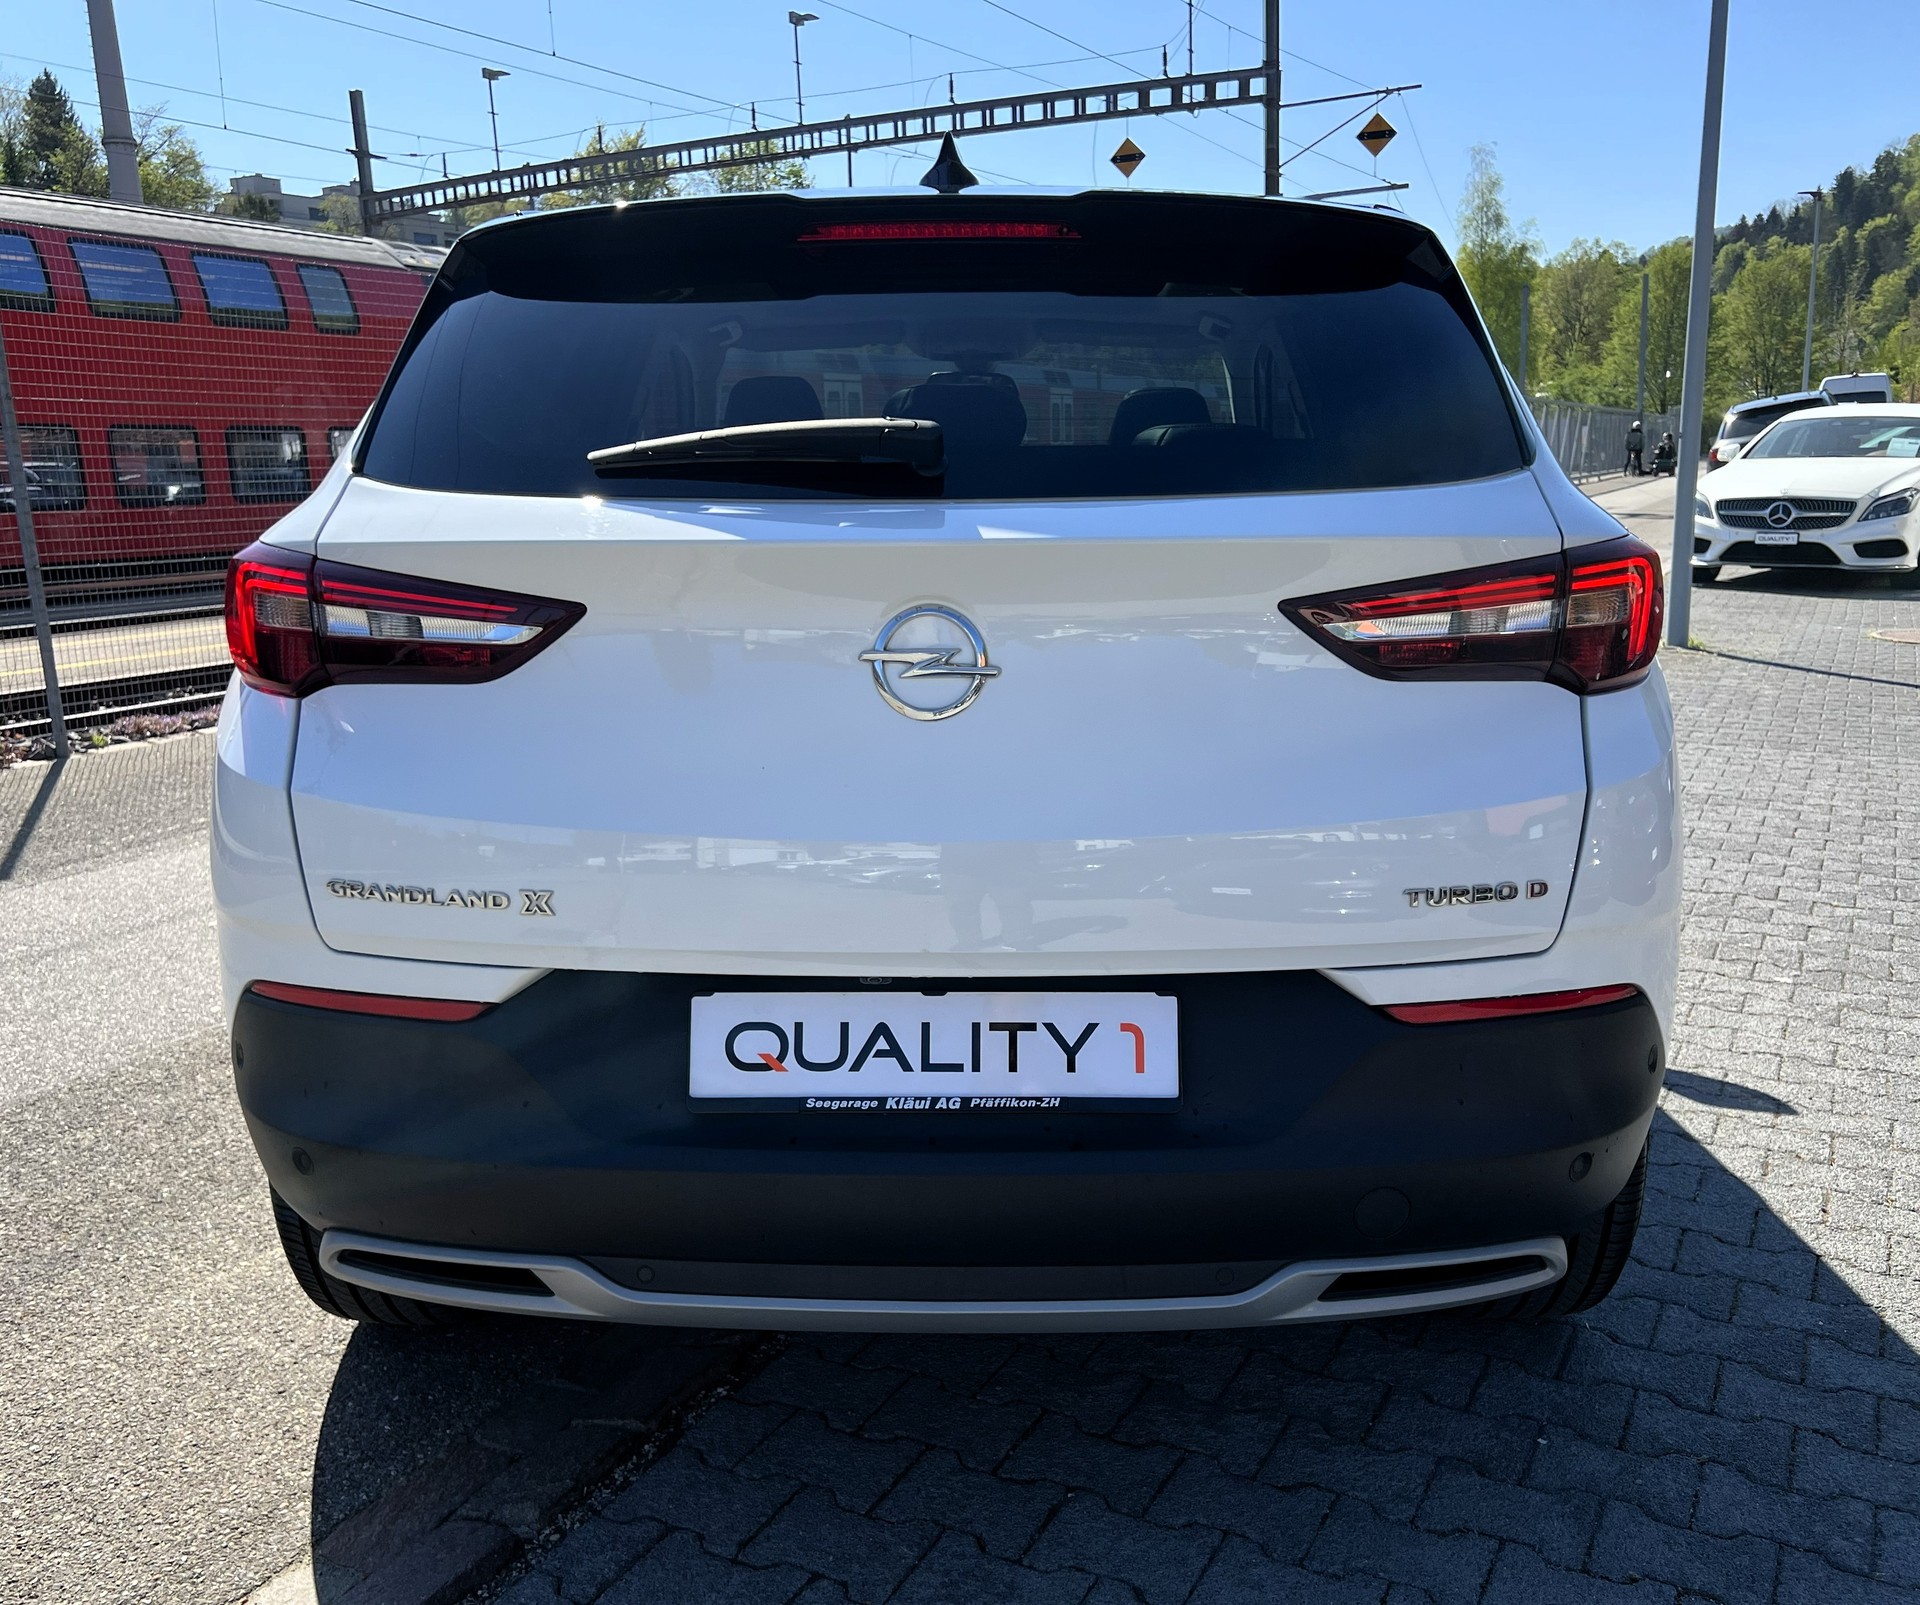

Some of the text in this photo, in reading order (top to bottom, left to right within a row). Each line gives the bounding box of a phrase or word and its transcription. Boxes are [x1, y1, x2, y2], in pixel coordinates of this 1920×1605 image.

[326, 878, 556, 916] GRANDLAND X
[1402, 879, 1549, 908] TURBO D
[724, 1021, 1145, 1074] QUALITY 1
[805, 1096, 1060, 1110] Seegarage Kläui AG Pfäffikon-ZH
